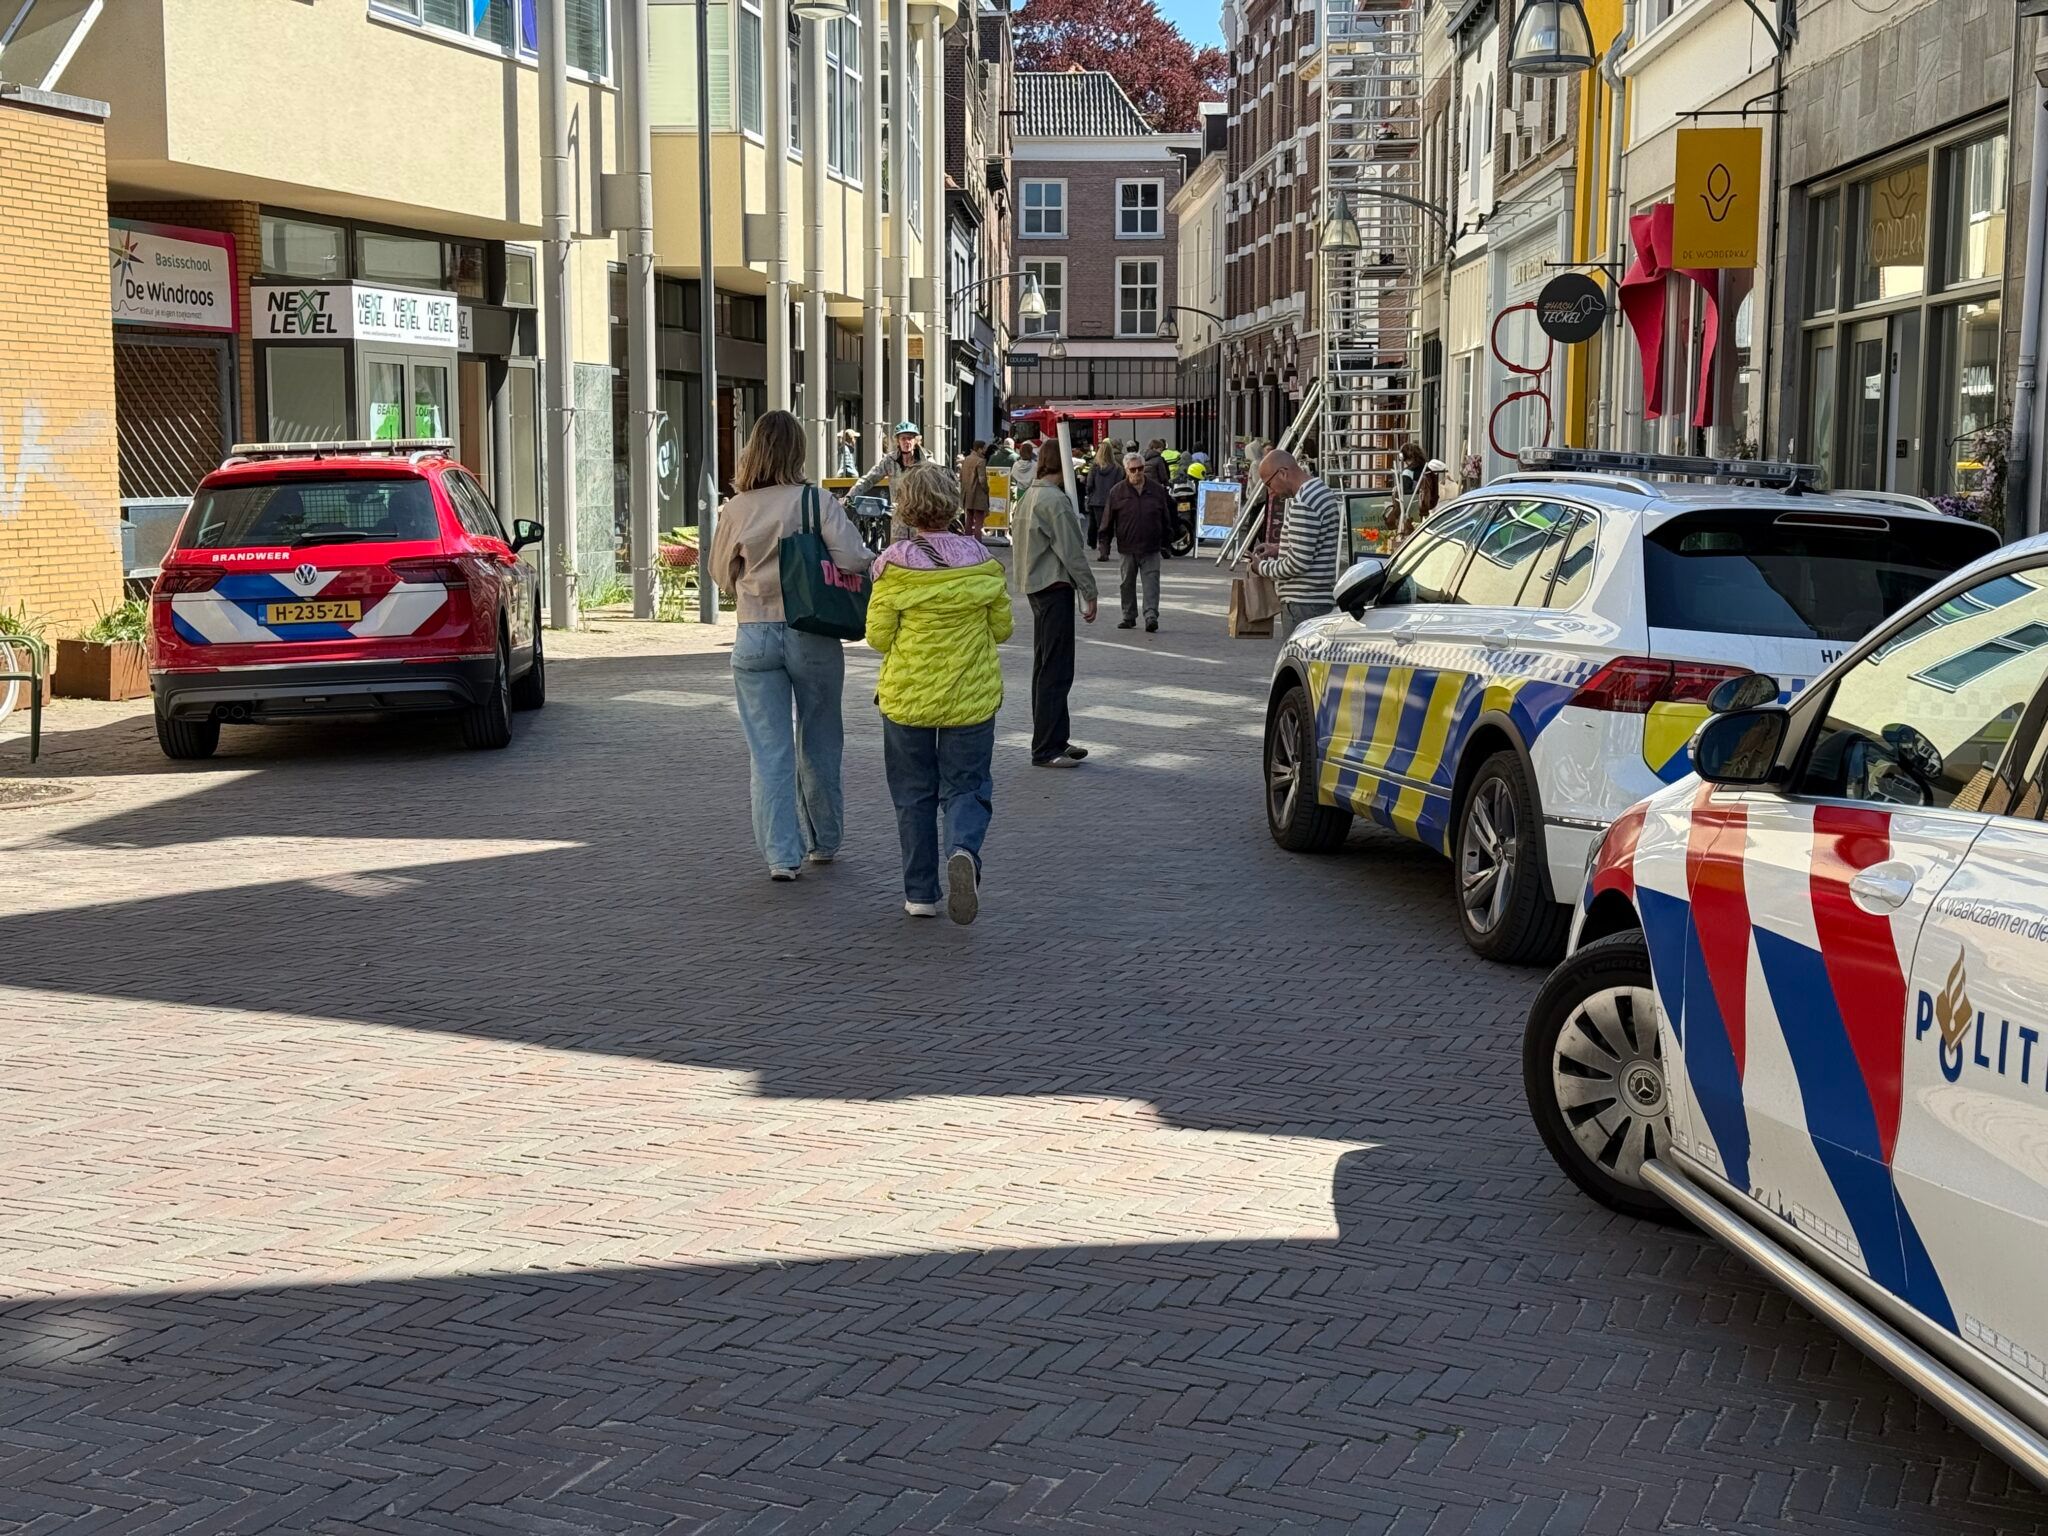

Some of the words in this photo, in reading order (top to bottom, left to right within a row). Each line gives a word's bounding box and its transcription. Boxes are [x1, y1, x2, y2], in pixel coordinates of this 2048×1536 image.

[155, 252, 212, 272] Basisschool
[1683, 250, 1693, 260] DE
[1696, 248, 1749, 259] WONDERKAS
[125, 279, 144, 300] De
[146, 281, 214, 307] Windroos
[267, 289, 330, 313] NEXT
[358, 293, 383, 310] NEXT
[393, 297, 418, 313] NEXT
[427, 301, 451, 317] NEXT
[270, 313, 338, 335] LEVEL
[359, 310, 386, 327] LEVEL
[394, 313, 421, 330] LEVEL
[428, 316, 454, 333] LEVEL
[1542, 311, 1581, 324] TECKEL
[212, 552, 290, 562] BRANDWEER
[275, 604, 354, 621] H-235-ZL
[2010, 916, 2029, 936] en
[2027, 915, 2048, 943] die
[1916, 990, 2048, 1093] POLIT
